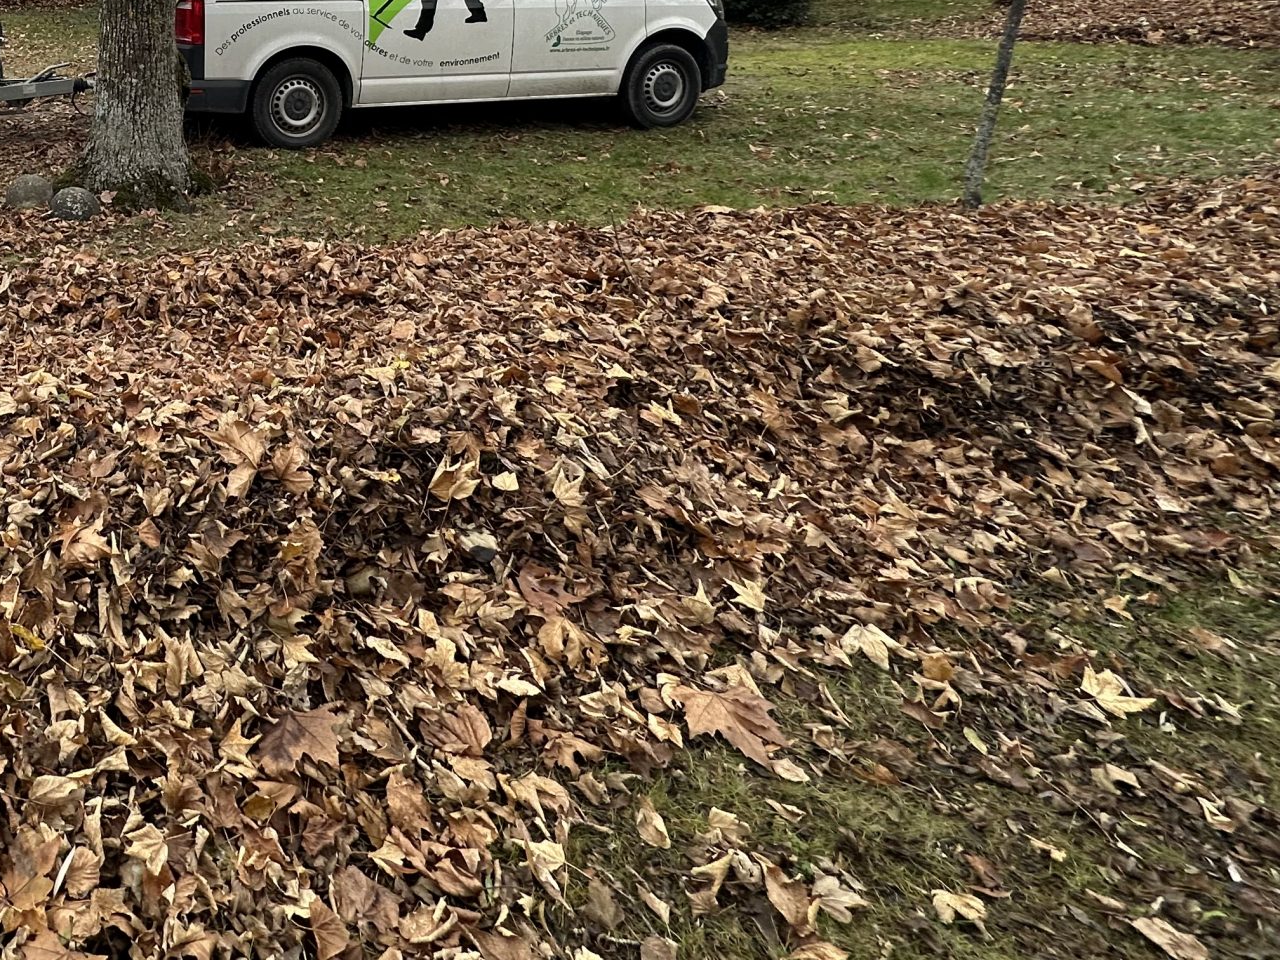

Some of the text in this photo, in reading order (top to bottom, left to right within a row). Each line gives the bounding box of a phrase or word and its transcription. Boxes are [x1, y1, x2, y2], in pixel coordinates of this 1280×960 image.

[215, 39, 232, 56] Des
[230, 8, 291, 42] professionnels
[306, 7, 338, 22] service
[338, 19, 350, 30] de
[350, 28, 363, 41] vos
[364, 39, 388, 58] arbres
[389, 53, 398, 61] et
[399, 55, 411, 65] de
[413, 58, 434, 67] votre
[439, 51, 500, 68] environnement
[545, 23, 568, 43] ARBRES
[575, 9, 611, 35] TECHNIQUES
